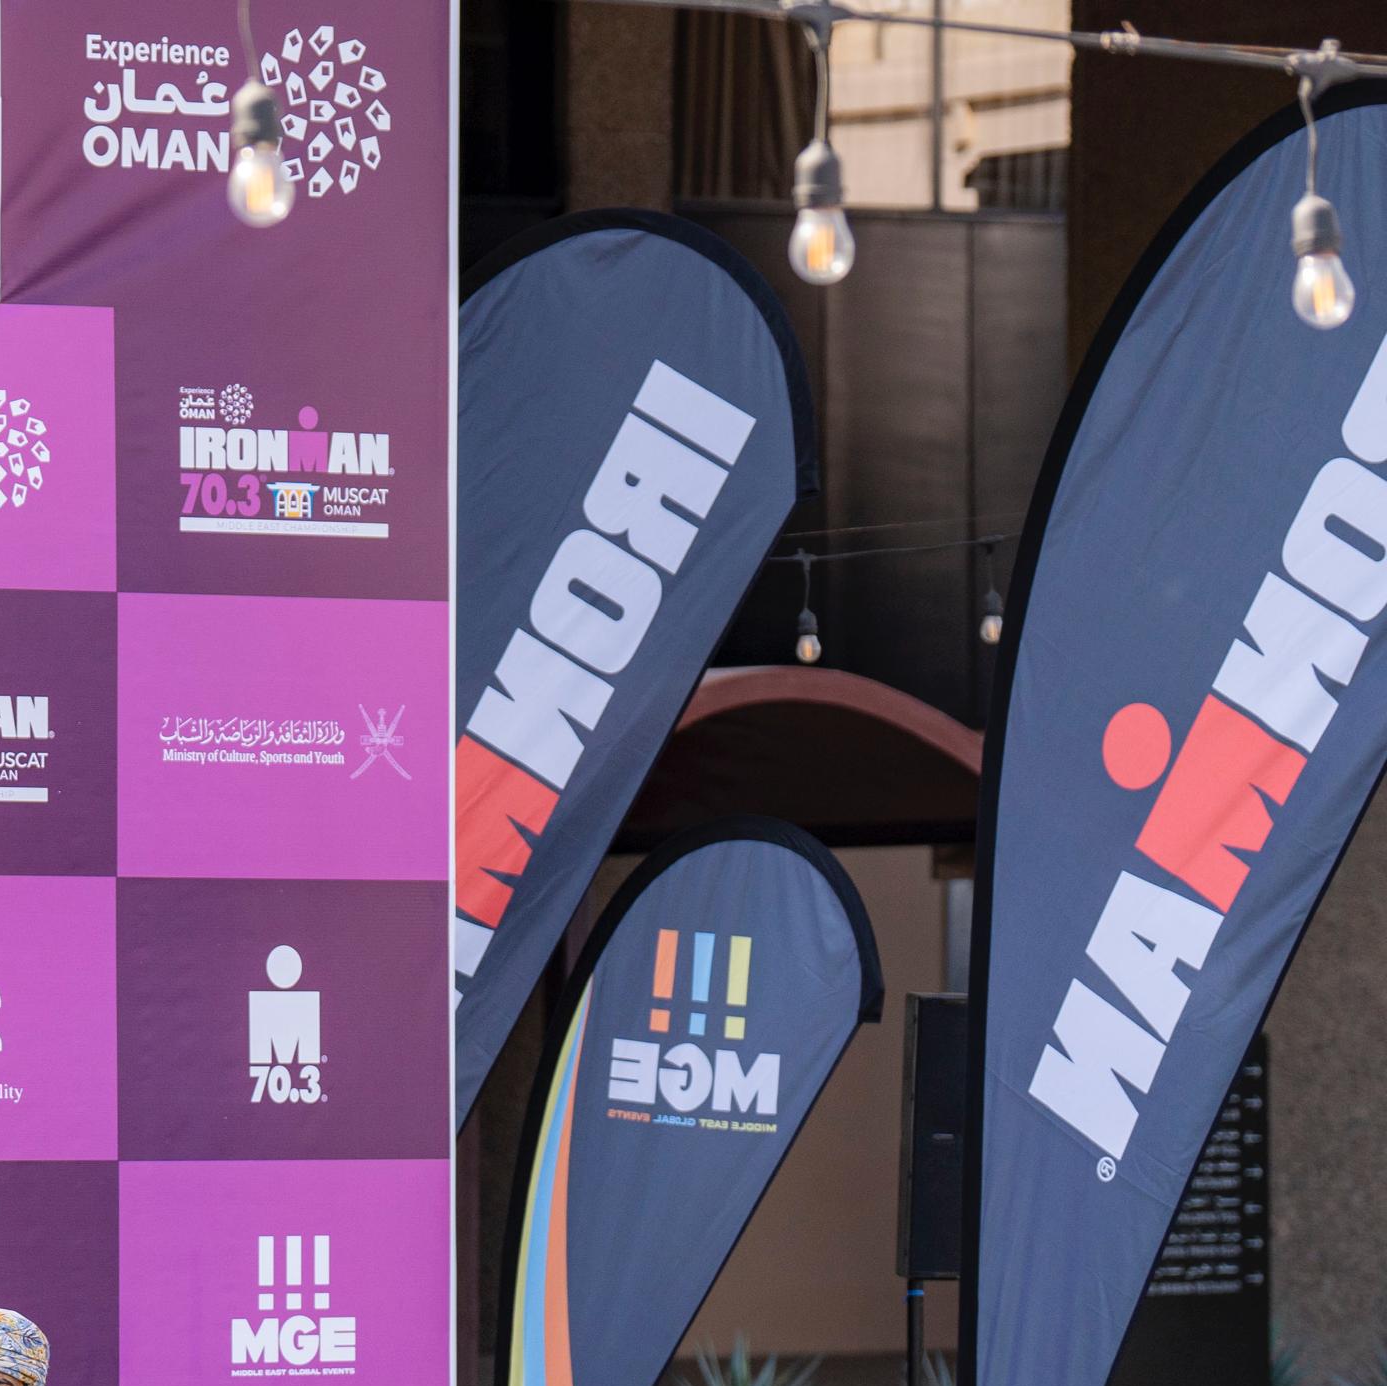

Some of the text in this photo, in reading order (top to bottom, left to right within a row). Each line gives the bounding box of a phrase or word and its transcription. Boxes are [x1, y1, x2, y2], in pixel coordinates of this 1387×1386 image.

[86, 34, 229, 66] Experience
[83, 125, 229, 172] OMAN
[180, 387, 215, 395] Experience
[179, 408, 215, 419] OMAN
[324, 486, 388, 504] MUSCAT
[324, 505, 361, 516] OMAN
[163, 749, 206, 764] Ministry
[208, 749, 218, 761] of
[260, 751, 291, 765] Sports
[293, 752, 312, 763] and
[315, 752, 344, 764] Youth
[232, 1315, 355, 1365] MGE
[232, 1369, 263, 1377] MIDDLE
[323, 1367, 355, 1375] EVENTS
